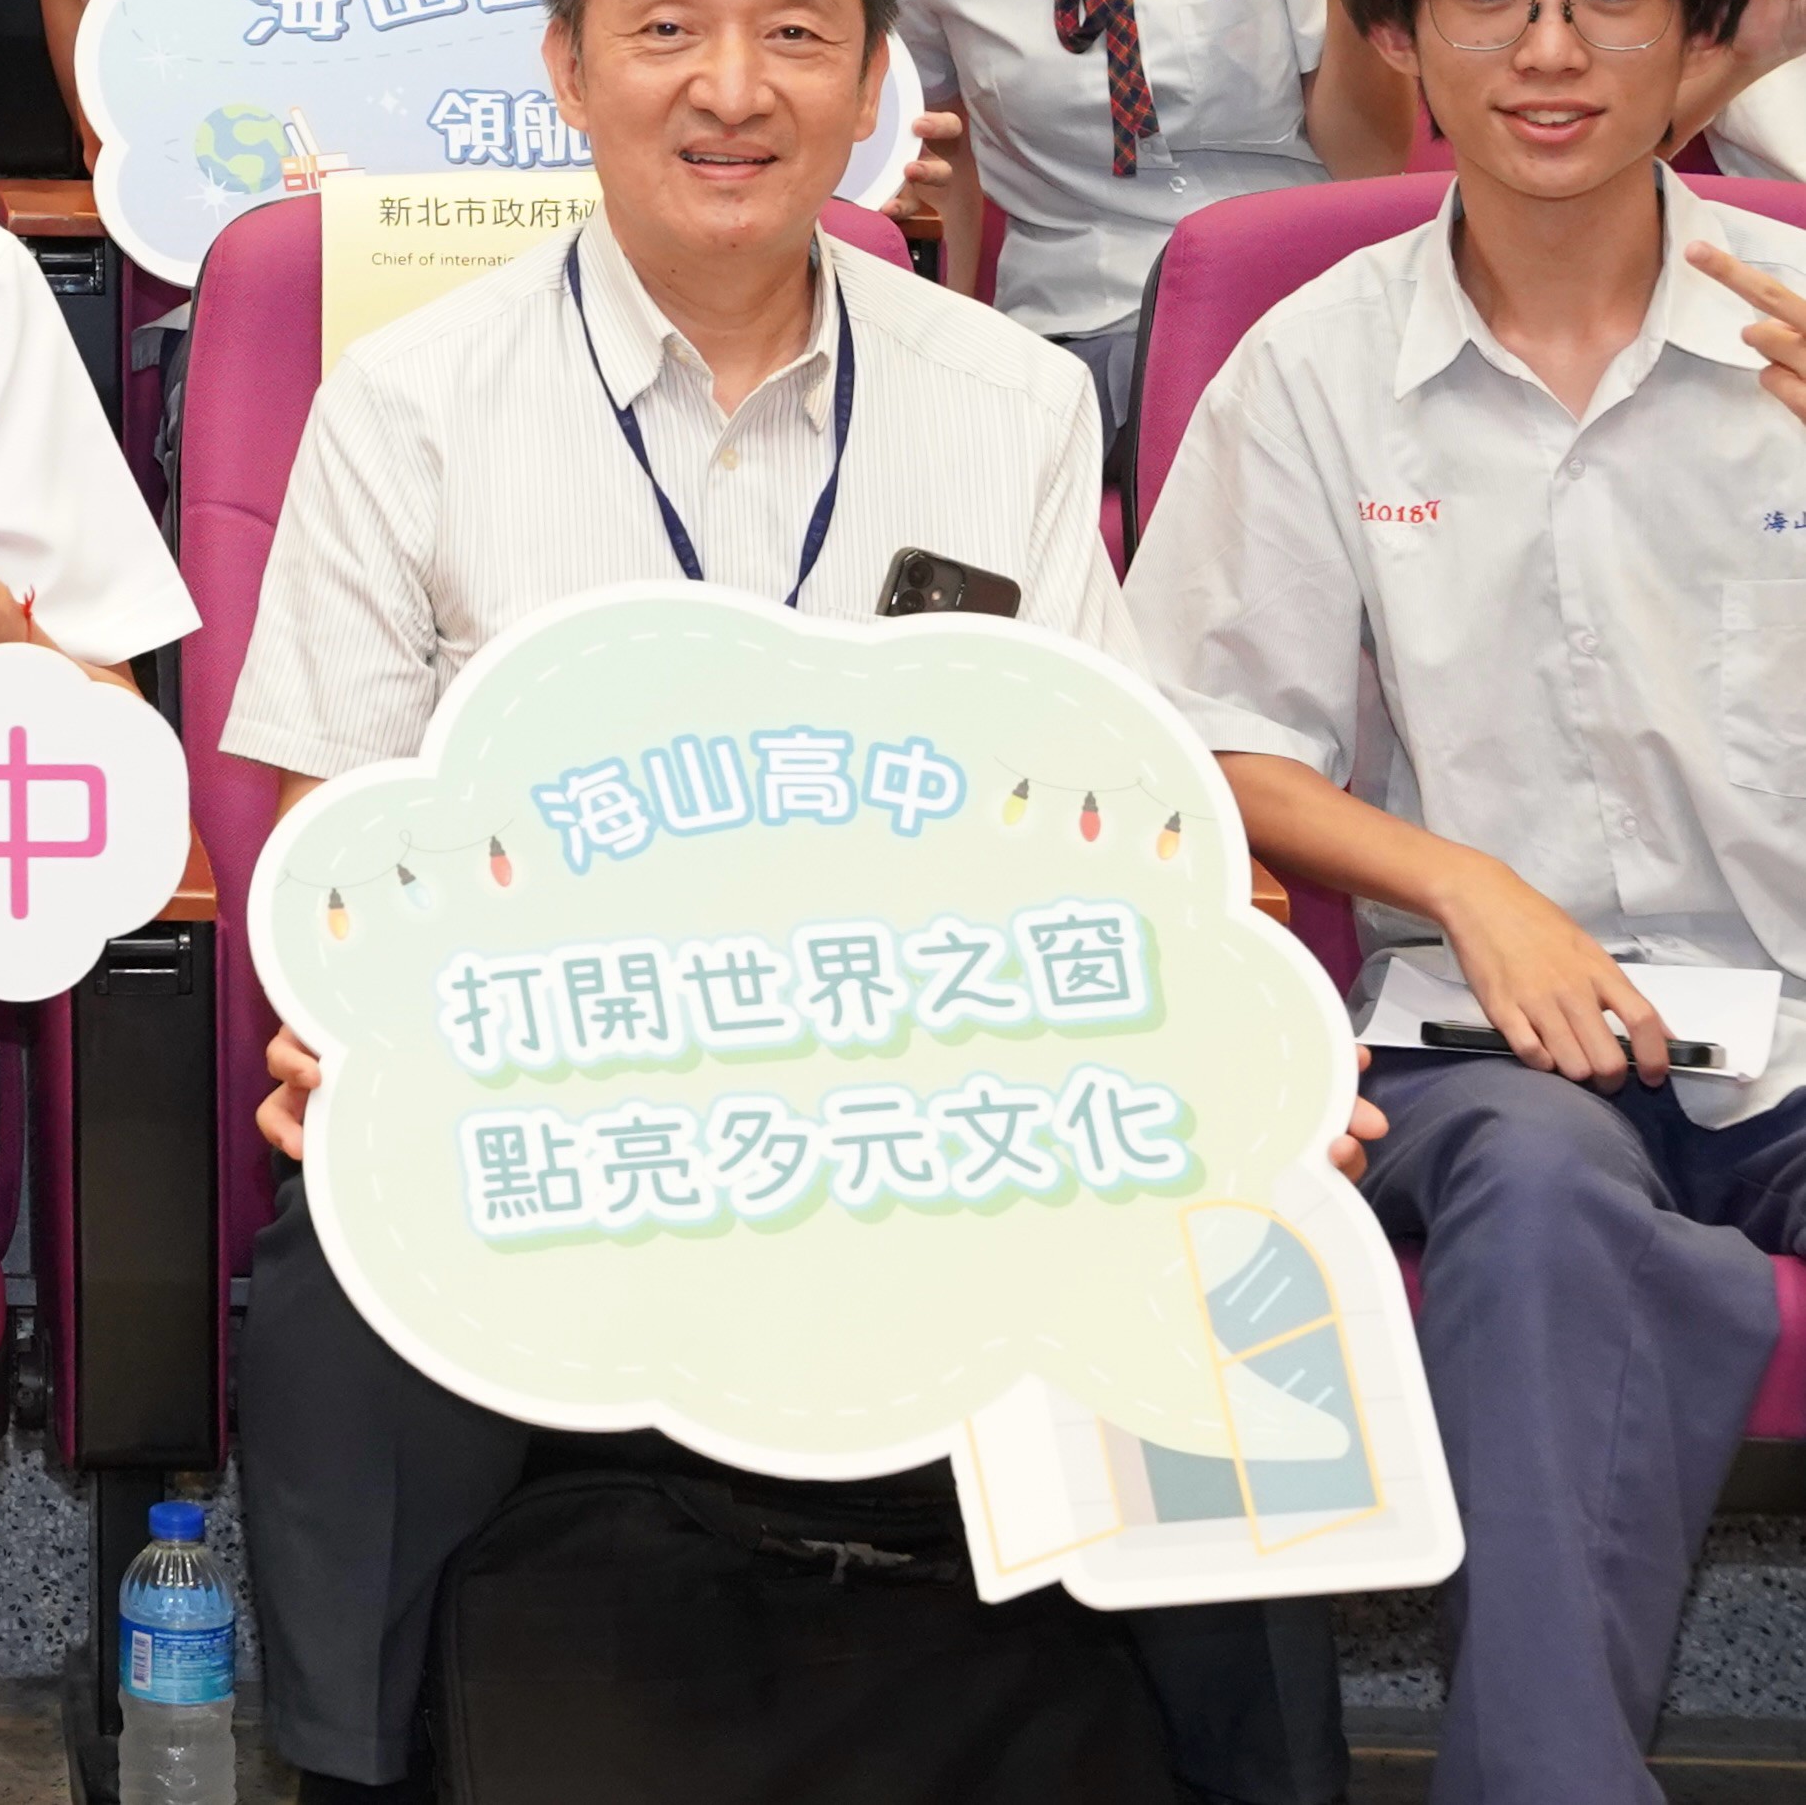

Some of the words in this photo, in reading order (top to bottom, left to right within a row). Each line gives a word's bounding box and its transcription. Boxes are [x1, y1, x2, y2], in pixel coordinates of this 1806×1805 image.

[371, 251, 413, 266] Chief
[418, 251, 435, 266] of
[534, 725, 966, 872] 海山高中
[450, 913, 1132, 1058] 打開世界之窗
[477, 1079, 1171, 1219] 點亮多元文化
